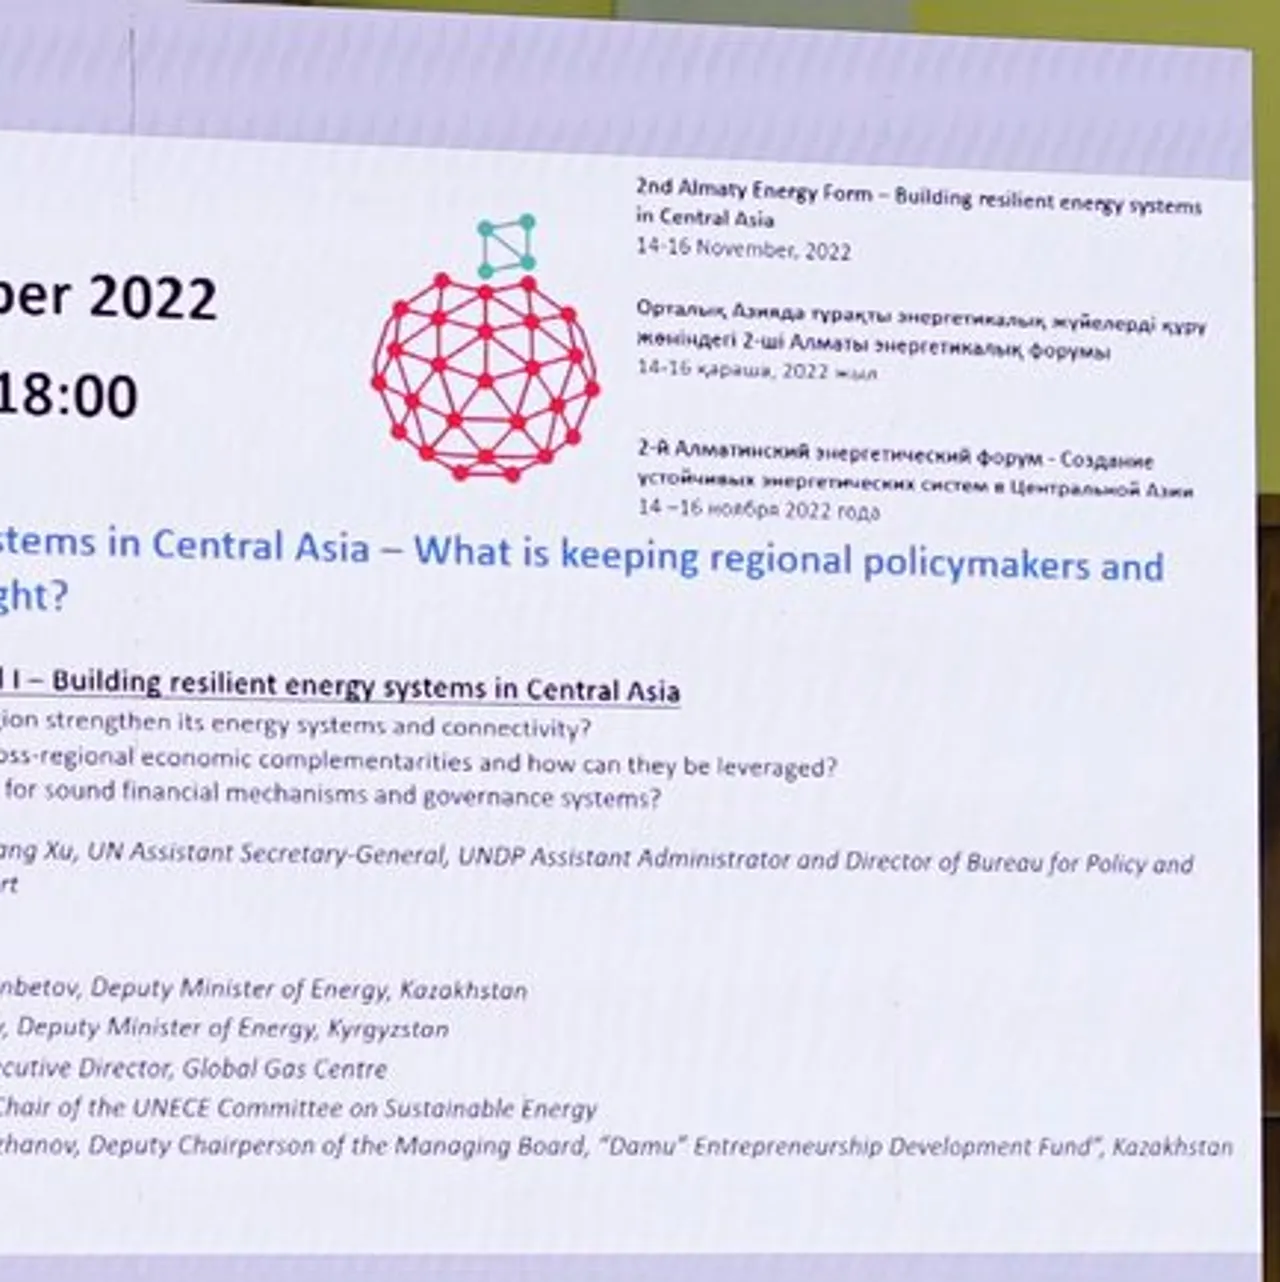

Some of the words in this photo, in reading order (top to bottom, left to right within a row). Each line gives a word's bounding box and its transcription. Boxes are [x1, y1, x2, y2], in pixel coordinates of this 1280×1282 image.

[635, 175, 675, 197] 2nd
[676, 177, 749, 203] Almaty
[751, 179, 820, 206] Energy
[822, 182, 875, 203] Form
[893, 185, 974, 212] Building
[978, 189, 1056, 211] resilient
[1059, 196, 1126, 218] energy
[1128, 198, 1203, 218] systems
[658, 206, 731, 231] Central
[733, 209, 776, 230] Asia
[637, 235, 692, 256] 14-16
[695, 237, 800, 262] November,
[804, 241, 852, 262] 2022
[88, 272, 219, 322] 2022
[108, 523, 141, 558] in
[152, 527, 284, 562] Central
[294, 530, 370, 564] Asia
[413, 532, 513, 568] What
[523, 534, 550, 569] is
[560, 535, 701, 581] keeping
[710, 540, 852, 582] regional
[863, 543, 1092, 586] policymakers
[1100, 551, 1165, 583] and
[51, 667, 164, 695] Building
[169, 669, 279, 697] resilient
[284, 675, 377, 699] energy
[382, 676, 489, 701] systems
[494, 675, 520, 701] in
[525, 676, 621, 703] Central
[625, 678, 682, 704] Asia
[45, 709, 172, 742] strengthen
[210, 717, 291, 741] energy
[296, 715, 388, 741] systems
[391, 715, 436, 738] and
[440, 717, 593, 746] connectivity?
[140, 747, 253, 770] economic
[258, 748, 474, 775] complementarities
[479, 752, 522, 774] and
[526, 752, 577, 775] how
[581, 758, 622, 776] can
[627, 755, 678, 781] they
[716, 755, 839, 785] leveraged?
[4, 776, 39, 801] for
[43, 778, 117, 803] sound
[121, 778, 220, 803] financial
[225, 781, 369, 805] mechanisms
[373, 783, 418, 806] and
[421, 788, 555, 811] governance
[560, 786, 663, 813] systems?
[42, 839, 80, 865] Xu,
[87, 840, 125, 862] UN
[128, 841, 235, 864] Assistant
[239, 841, 450, 870] Secretary-General,
[457, 844, 527, 868] UNDP
[529, 846, 633, 869] Assistant
[636, 845, 792, 871] Administrator
[796, 849, 841, 871] and
[844, 850, 933, 873] Director
[965, 851, 1045, 874] Bureau
[1085, 853, 1149, 879] Policy
[1151, 853, 1195, 876] and
[89, 974, 175, 1005] Deputy
[179, 976, 277, 1000] Minister
[309, 977, 392, 1006] Energy,
[399, 978, 529, 1002] Kazakhstan
[16, 1014, 102, 1043] Deputy
[105, 1015, 203, 1044] Minister
[237, 1015, 320, 1045] Energy,
[326, 1017, 450, 1045] Kyrgyzstan
[77, 1056, 175, 1082] Director,
[181, 1055, 260, 1081] Global
[262, 1057, 308, 1081] Gas
[312, 1057, 389, 1081] Centre
[87, 1095, 128, 1119] the
[131, 1096, 212, 1119] UNECE
[216, 1096, 344, 1120] Committee
[382, 1096, 516, 1120] Sustainable
[520, 1098, 598, 1125] Energy
[87, 1133, 173, 1160] Deputy
[177, 1133, 316, 1160] Chairperson
[350, 1133, 389, 1157] the
[394, 1134, 512, 1162] Managing
[516, 1133, 591, 1160] Board,
[693, 1135, 884, 1160] Entrepreneurship
[888, 1135, 1033, 1161] Development
[1112, 1135, 1234, 1157] Kazakhstan
